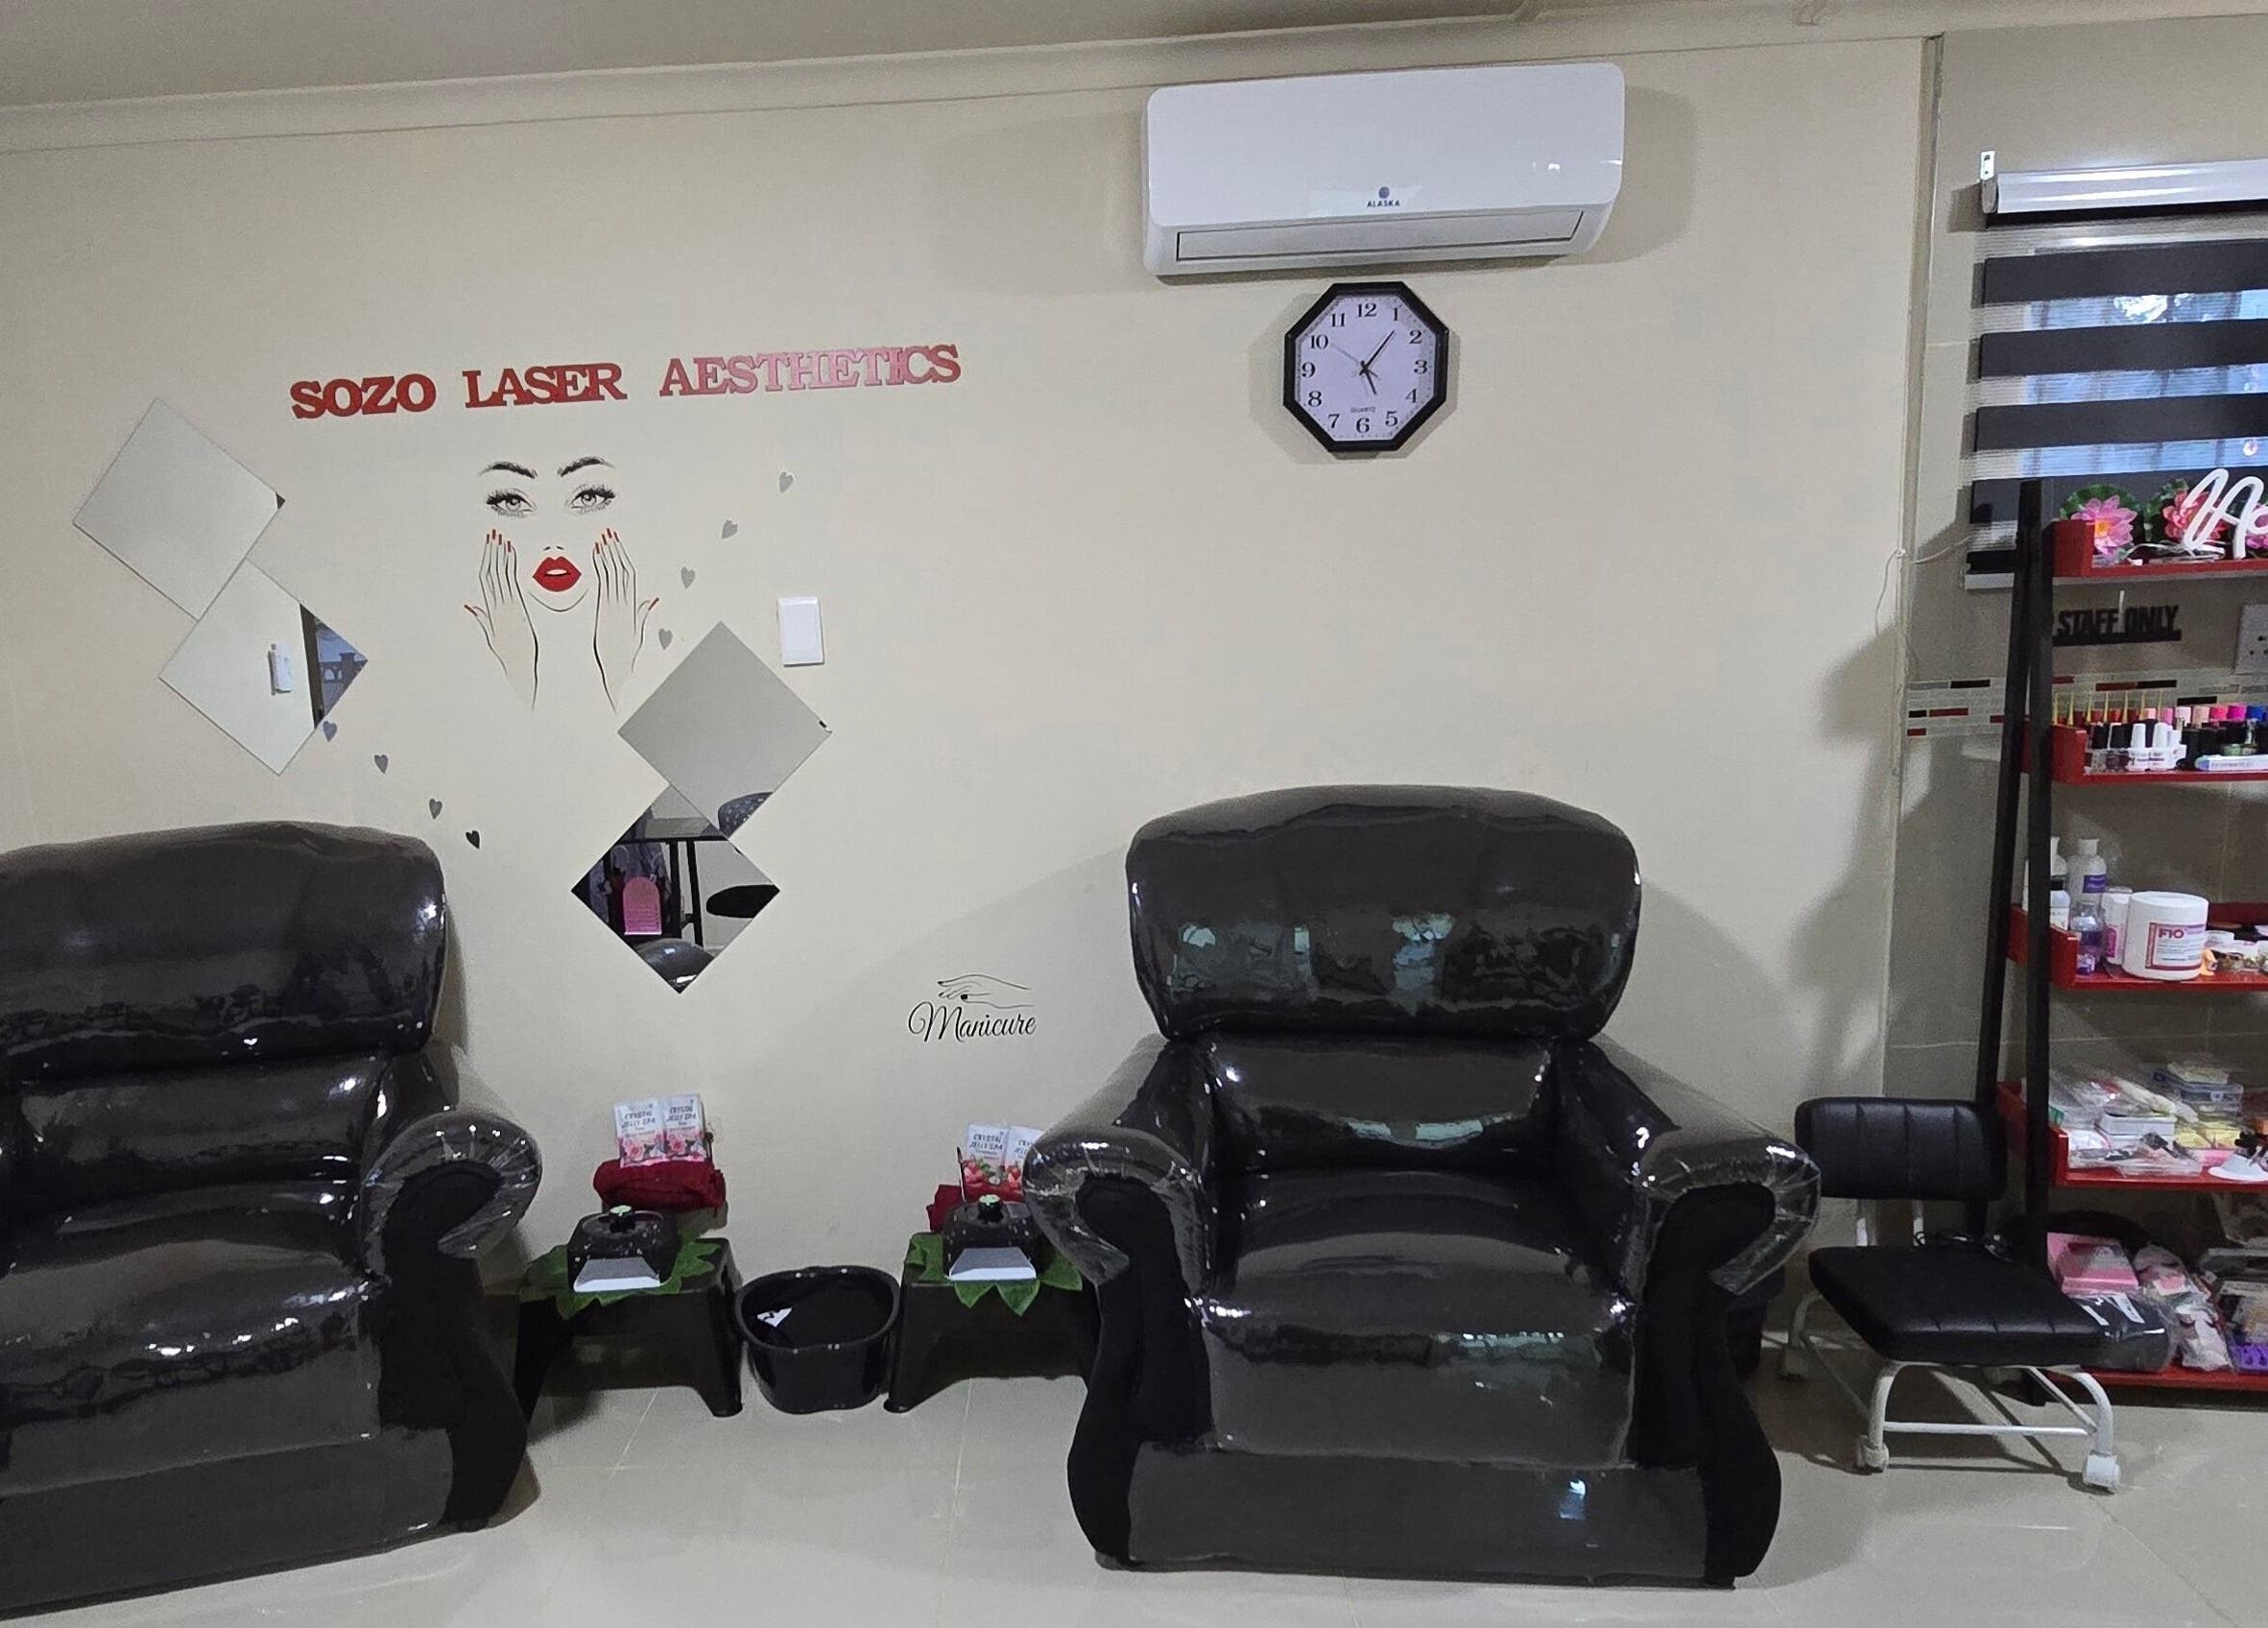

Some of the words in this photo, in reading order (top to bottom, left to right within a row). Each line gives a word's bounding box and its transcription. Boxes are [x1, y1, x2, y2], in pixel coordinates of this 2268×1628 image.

[1357, 302, 1377, 318] 12
[1393, 307, 1398, 321] 1
[1331, 313, 1346, 327] 11
[1310, 335, 1328, 349] 10
[1409, 329, 1422, 344] 2
[1301, 362, 1316, 378] 9
[1414, 360, 1428, 374] 3
[290, 373, 437, 419] SOZO
[462, 362, 628, 408] LASER
[659, 344, 962, 396] AESTHETICS
[1308, 390, 1323, 407] 8
[1405, 388, 1418, 403] 4
[1327, 414, 1341, 429] 7
[1356, 418, 1371, 433] 6
[1385, 411, 1398, 426] 5
[2057, 608, 2123, 634] STAFF
[2124, 605, 2179, 634] ONLY
[908, 1001, 1038, 1043] Manicure
